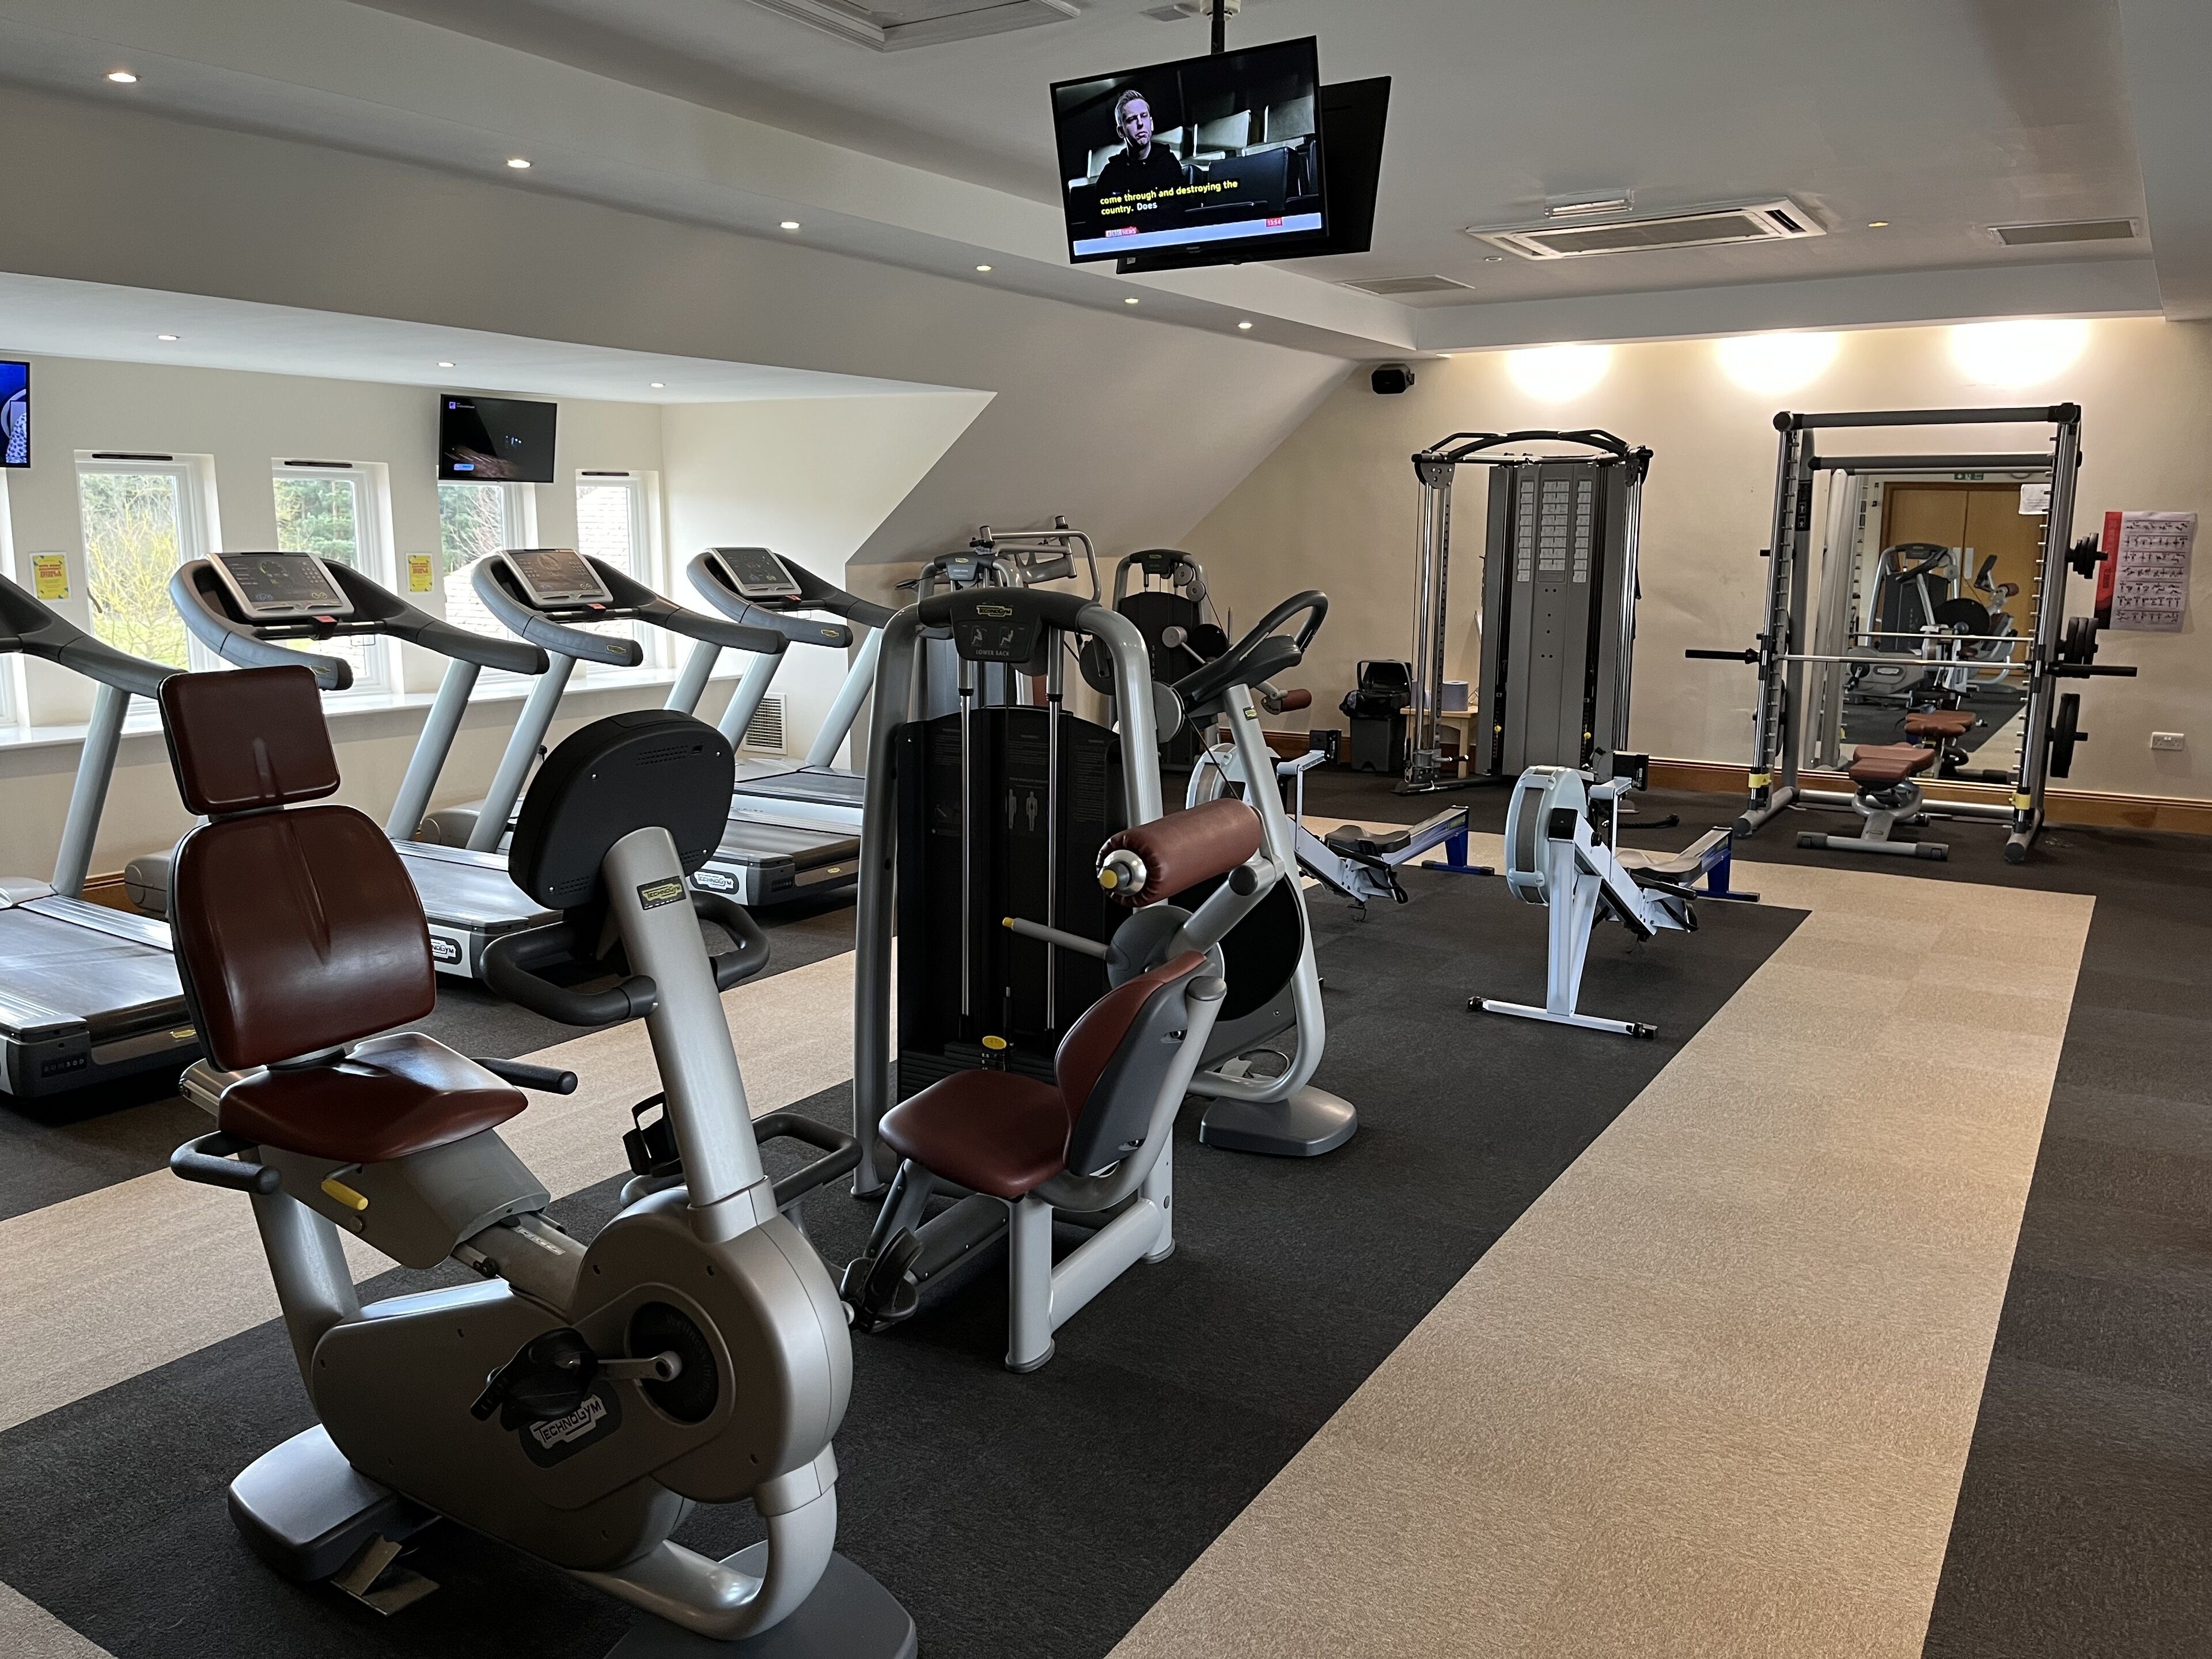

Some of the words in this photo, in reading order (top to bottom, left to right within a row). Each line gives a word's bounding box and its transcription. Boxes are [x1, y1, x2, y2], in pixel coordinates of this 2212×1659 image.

[1100, 196, 1122, 204] come
[1124, 191, 1157, 202] through
[1158, 188, 1174, 198] and
[1176, 183, 1221, 195] destroying
[1223, 180, 1238, 190] the
[1101, 205, 1134, 215] country.
[1137, 202, 1158, 211] Does
[643, 885, 681, 899] TECHNOGYM
[532, 1400, 602, 1444] TECHNOGYM
